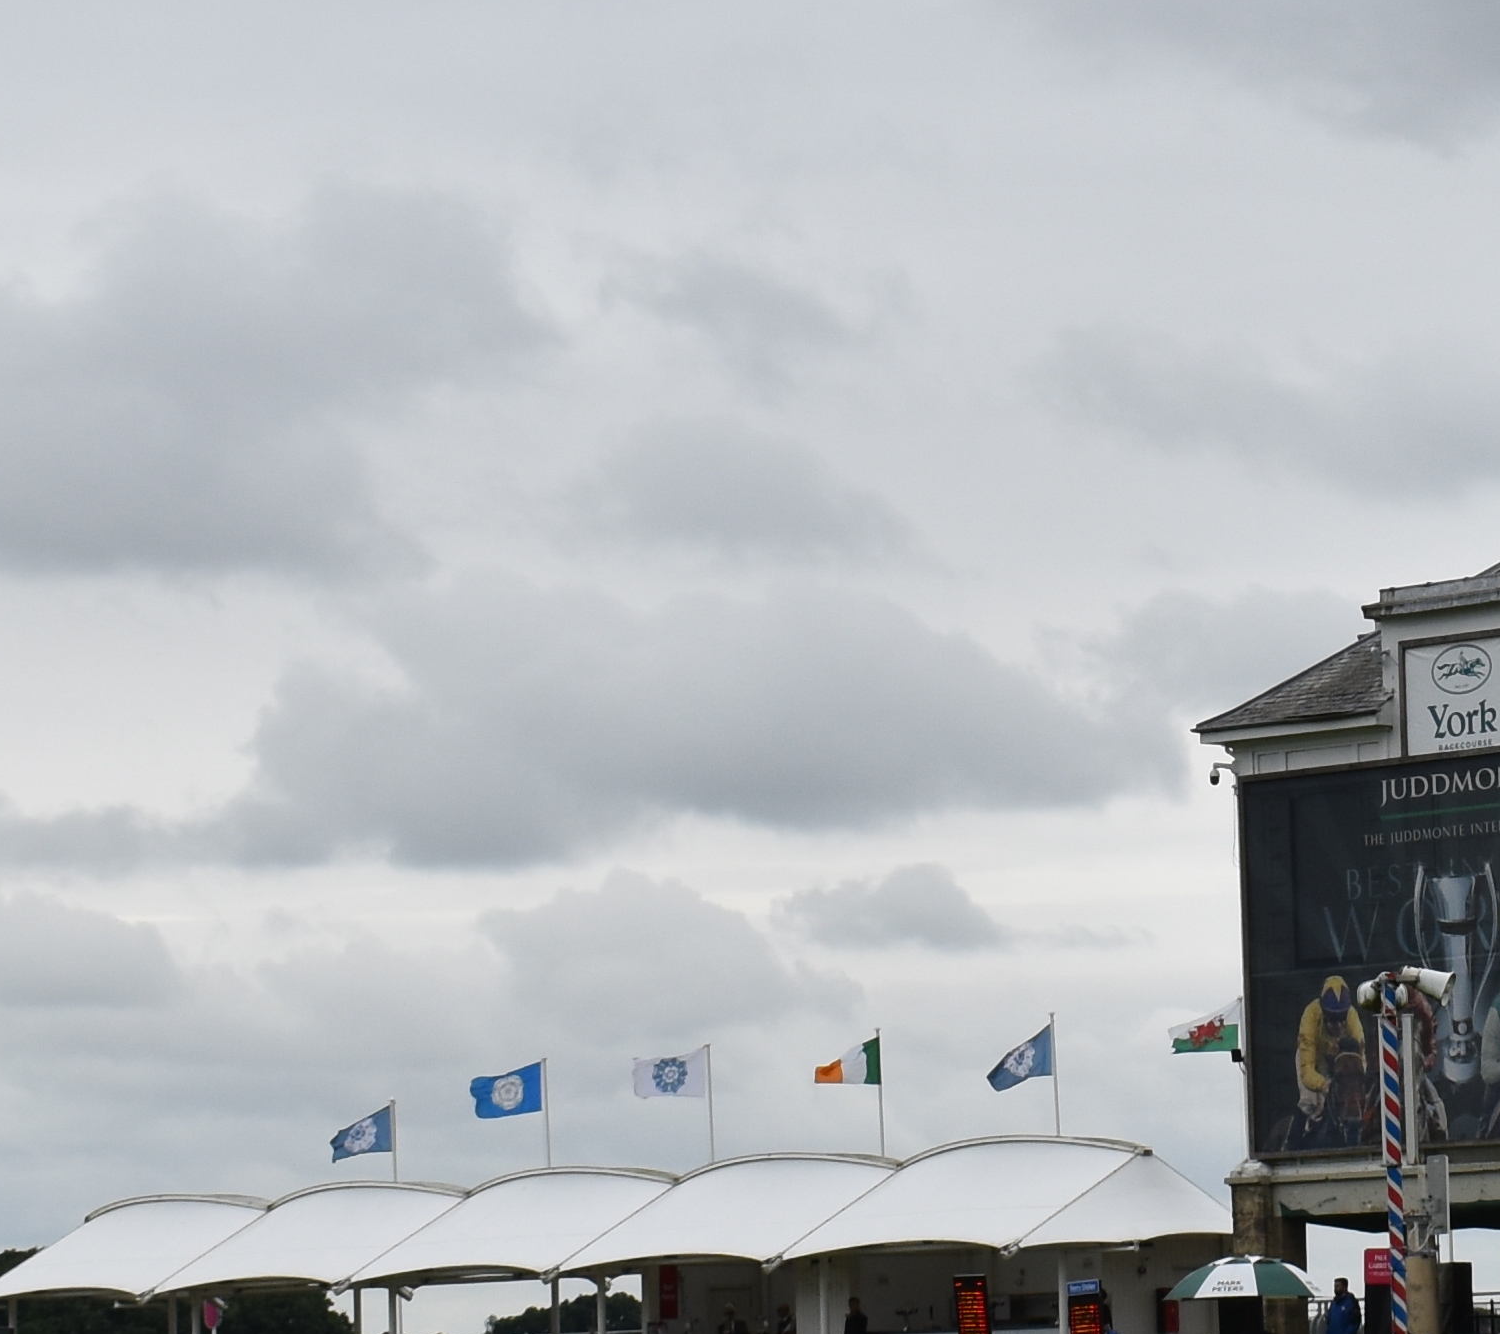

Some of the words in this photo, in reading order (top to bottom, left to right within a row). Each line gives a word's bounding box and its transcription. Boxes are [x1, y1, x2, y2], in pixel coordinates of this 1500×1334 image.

[1427, 699, 1498, 739] York
[1438, 739, 1493, 750] RACECOURSE
[1364, 834, 1385, 847] THE
[1390, 823, 1465, 845] JUDDMONTE
[1346, 862, 1420, 901] BEST
[1212, 1285, 1244, 1293] PETERS
